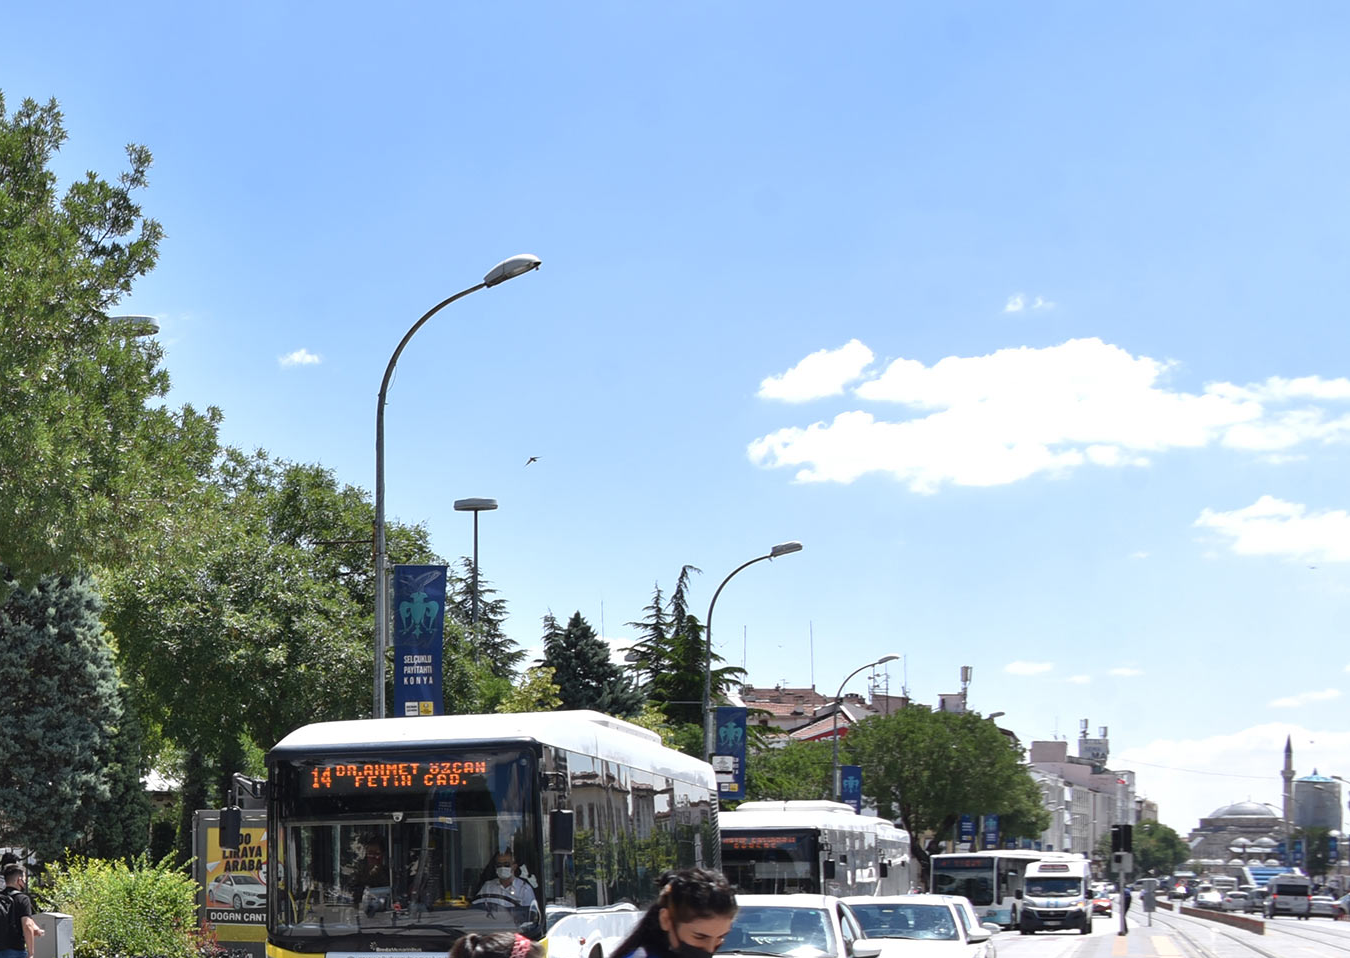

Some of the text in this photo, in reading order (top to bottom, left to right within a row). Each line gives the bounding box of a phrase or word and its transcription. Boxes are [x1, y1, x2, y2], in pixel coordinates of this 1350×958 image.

[403, 654, 432, 665] SELÇUKLU
[403, 676, 434, 685] KONYA
[429, 761, 487, 774] ÖZCAN
[311, 766, 332, 788] 14
[424, 774, 467, 786] CAD.
[224, 859, 262, 872] ARABA
[243, 912, 267, 921] CANT
